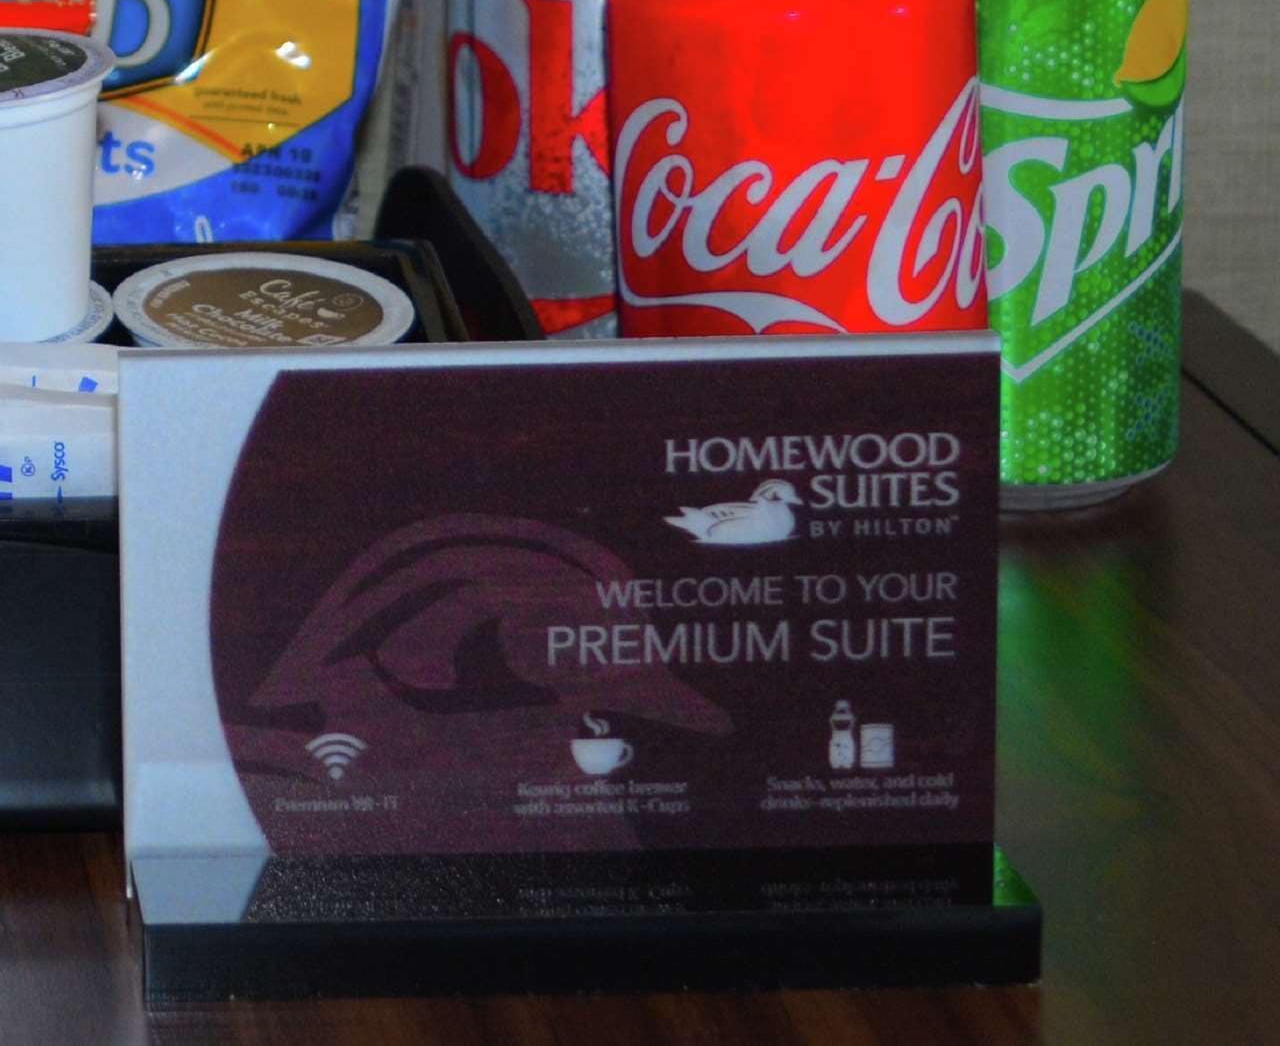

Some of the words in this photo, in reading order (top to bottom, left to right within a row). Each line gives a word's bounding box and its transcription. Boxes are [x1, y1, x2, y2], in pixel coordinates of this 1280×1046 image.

[240, 290, 329, 329] Escapes
[259, 279, 322, 309] Café
[191, 304, 293, 343] Chocolate
[234, 309, 285, 329] Milk
[51, 441, 68, 482] Sysco
[665, 433, 960, 473] HOMEWOOD
[810, 471, 960, 509] SUITES
[810, 520, 843, 538] BY
[854, 517, 952, 537] HILTON
[596, 576, 783, 609] WELCOME
[794, 574, 846, 604] TO
[856, 572, 958, 602] YOUR
[547, 621, 789, 666] PREMIUM
[810, 617, 956, 662] SUITE
[574, 781, 624, 795] coffee
[628, 781, 687, 795] brewer
[882, 775, 915, 789] and
[918, 774, 954, 788] cold
[513, 801, 550, 815] with
[553, 799, 624, 814] assorted
[919, 792, 958, 810] daily
